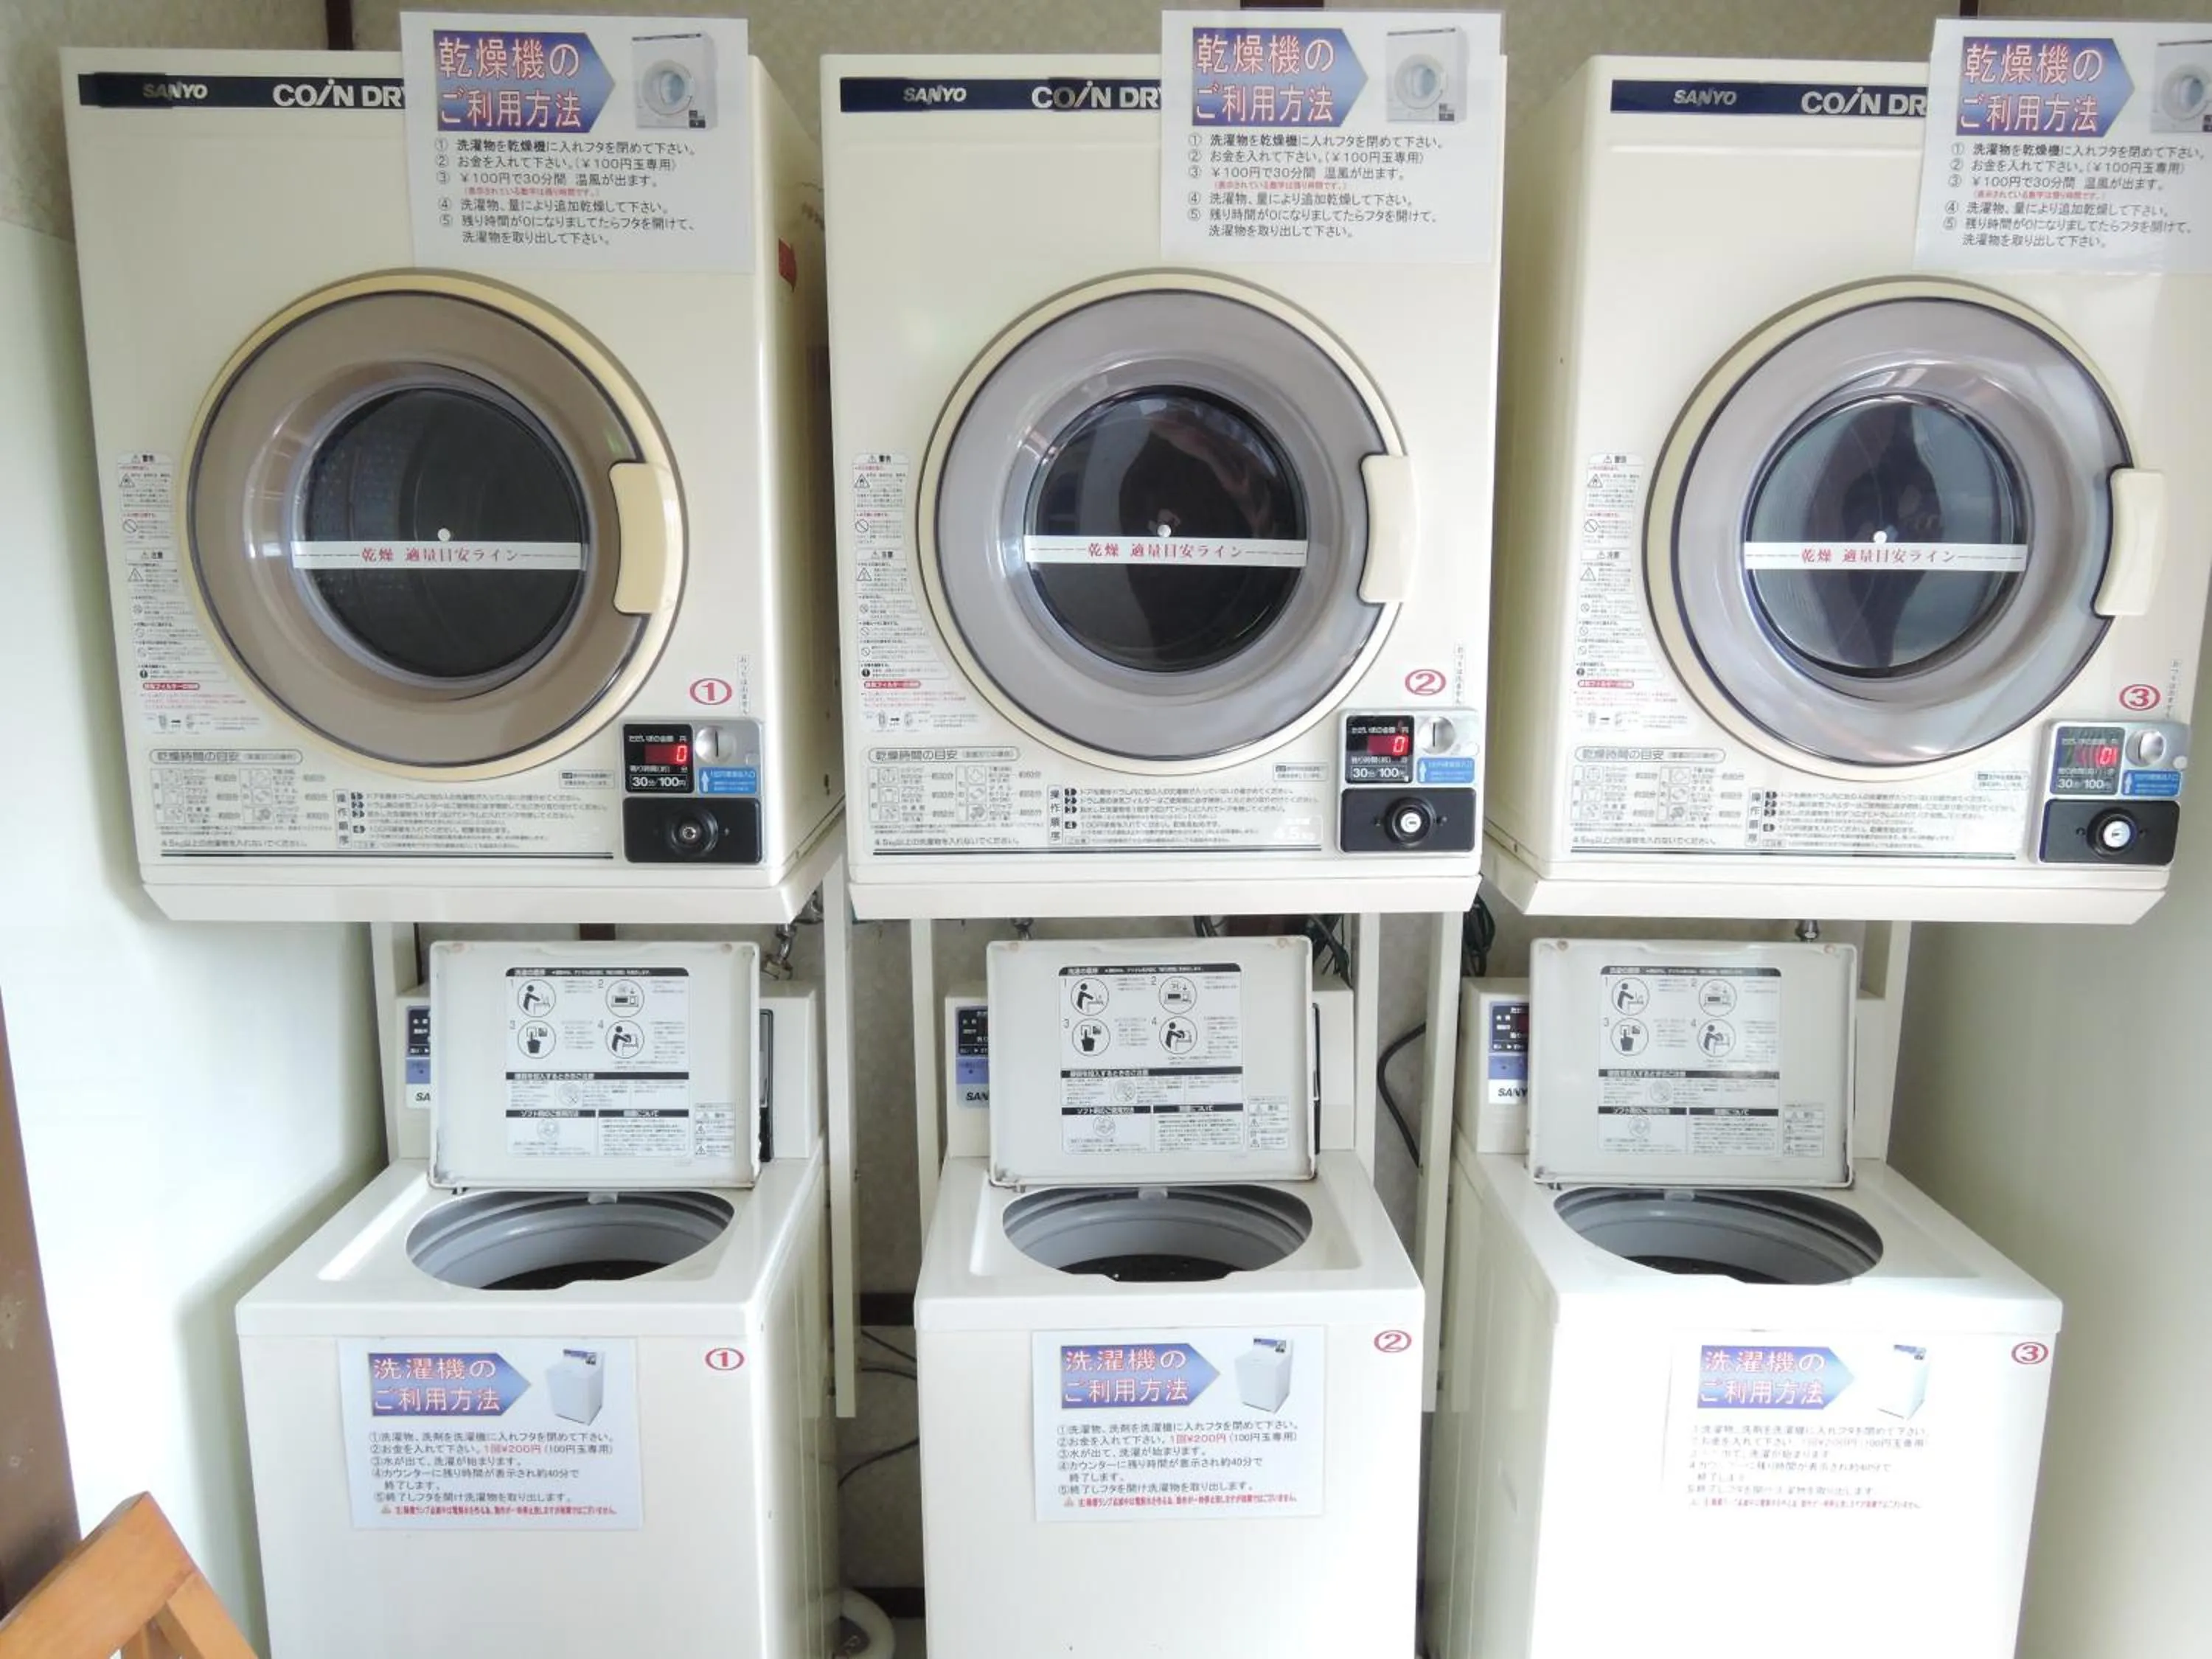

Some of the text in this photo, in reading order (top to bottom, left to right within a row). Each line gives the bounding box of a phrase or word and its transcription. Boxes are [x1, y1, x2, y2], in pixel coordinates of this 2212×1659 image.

[439, 38, 579, 80] 乾燥機の
[1197, 33, 1335, 74] 乾燥機の
[1965, 43, 2104, 84] 乾燥機の
[142, 81, 208, 100] SANYO
[361, 86, 405, 108] DR
[903, 85, 967, 105] SANYO
[1119, 87, 1161, 108] DR
[1197, 83, 1333, 122] ご利用方法
[1673, 87, 1737, 105] SANYO
[442, 86, 581, 128] ご利用方法
[1961, 93, 2098, 133] ご利用方法
[462, 232, 609, 245] 洗濯物を取り出して下さい。
[1209, 225, 1353, 237] 洗濯物を取り出して下さい。
[361, 547, 518, 563] 乾燥 適量目安ライン
[1088, 543, 1246, 558] 乾燥 適量目安ライン
[1801, 549, 1956, 564] 乾燥 適量目安ライン
[677, 745, 688, 762] 0
[876, 751, 957, 760] 乾燥時間の目安
[1393, 736, 1408, 753] 0
[2101, 747, 2112, 765] 0
[373, 1358, 495, 1380] 洗濯機の
[1065, 1349, 1186, 1371] 洗濯機の
[1705, 1352, 1825, 1373] 洗濯機の
[375, 1388, 501, 1411] ご利用方法
[1065, 1377, 1189, 1403] ご利用方法
[1700, 1380, 1823, 1405] ご利用方法
